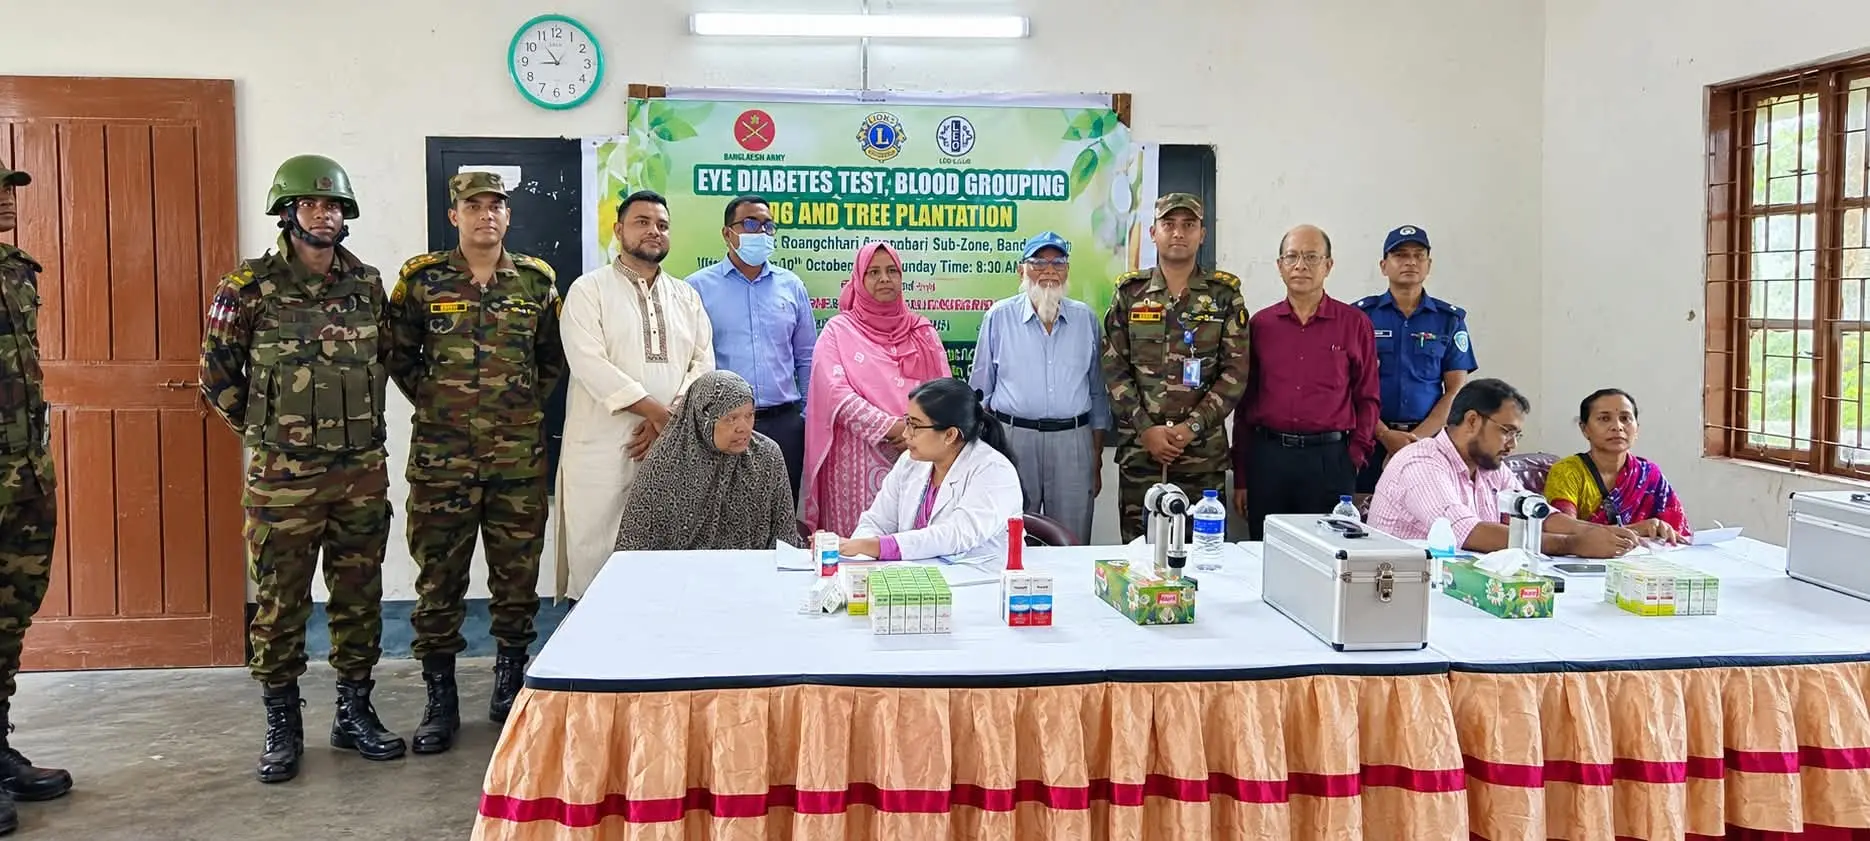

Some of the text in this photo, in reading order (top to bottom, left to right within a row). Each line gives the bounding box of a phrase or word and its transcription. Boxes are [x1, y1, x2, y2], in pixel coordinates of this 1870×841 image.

[537, 30, 546, 41] 11
[551, 27, 562, 38] 12
[526, 42, 537, 52] 10
[579, 43, 586, 53] 2
[521, 56, 529, 67] 9
[583, 58, 592, 69] 3
[527, 71, 534, 82] 8
[579, 74, 586, 83] 4
[538, 82, 546, 93] 7
[553, 87, 561, 97] 6
[568, 83, 576, 94] 5
[876, 127, 889, 144] L
[698, 168, 1065, 197] EYE DIABETES TEST, BLOOD GROUPING
[798, 202, 839, 225] AND
[843, 203, 890, 227] TREE
[896, 204, 1012, 227] PLANTATION
[781, 235, 859, 252] Roangchhari
[933, 236, 993, 253] Sub-Zone,
[901, 260, 936, 276] unday
[940, 259, 973, 273] Time:
[976, 260, 1001, 273] 8:30
